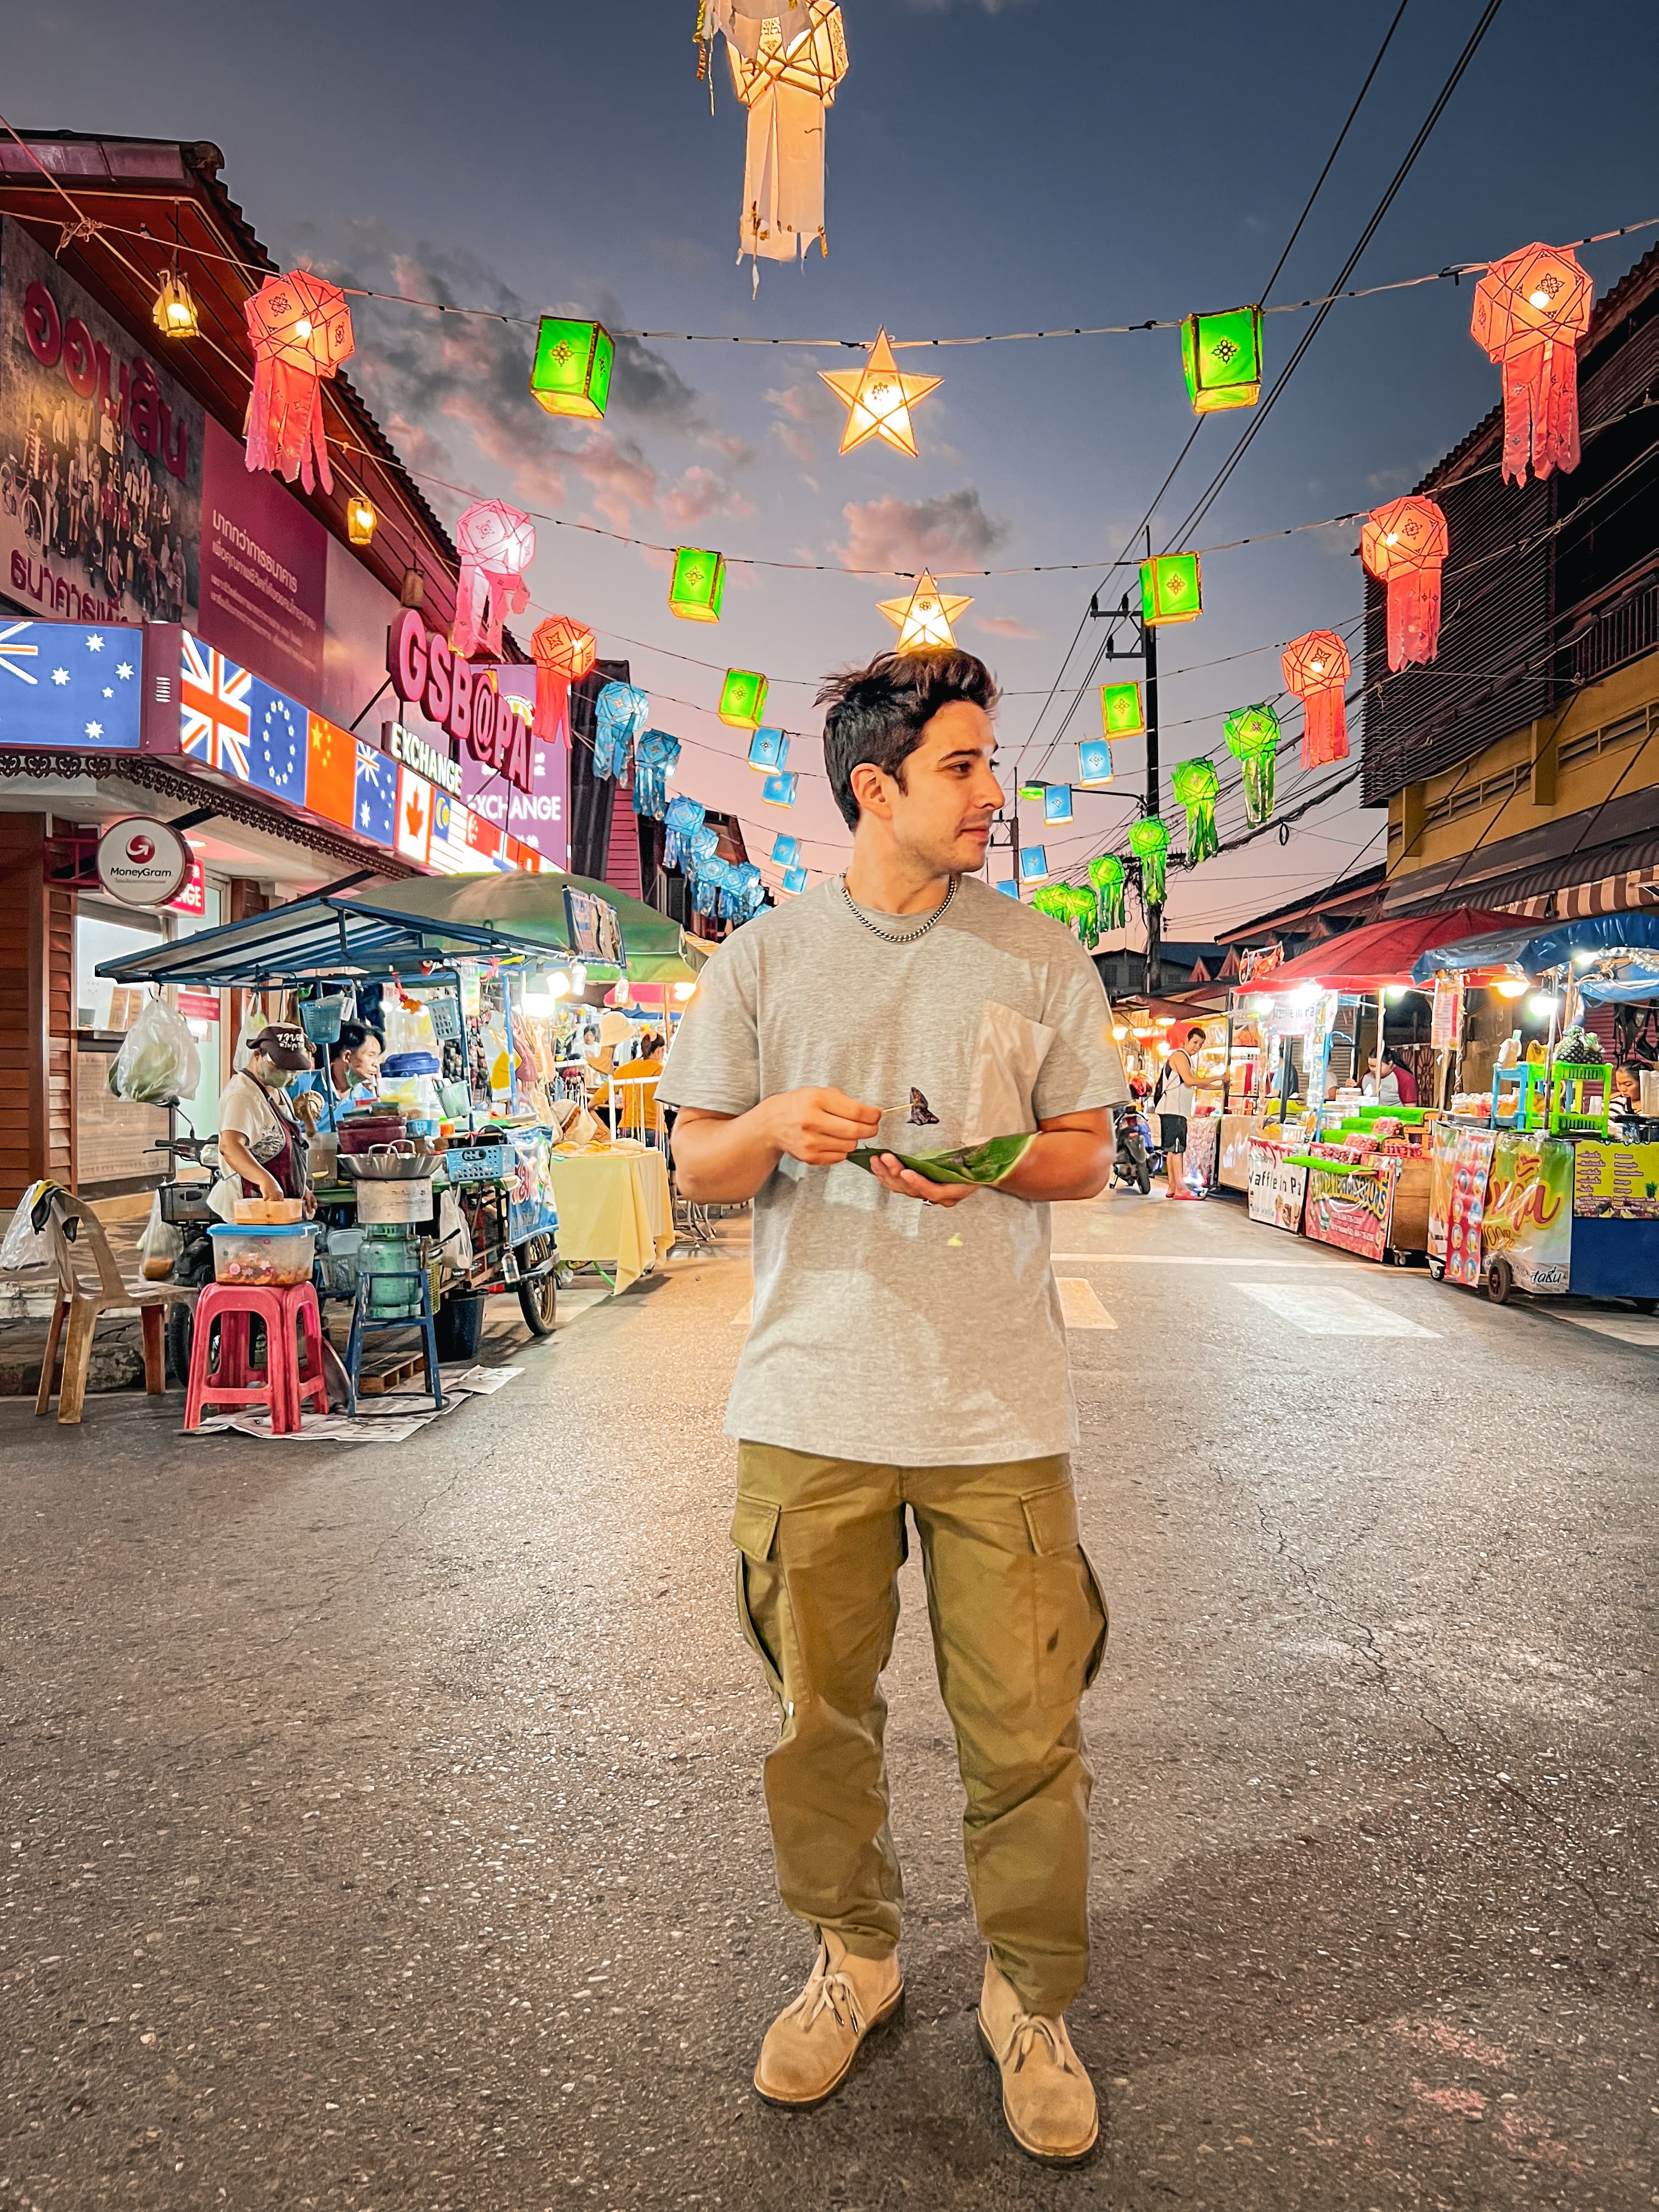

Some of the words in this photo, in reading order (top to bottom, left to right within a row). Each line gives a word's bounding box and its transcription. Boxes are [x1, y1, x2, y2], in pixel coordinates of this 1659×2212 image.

[24, 281, 187, 484] ออมสิน
[399, 609, 535, 794] GSB@PAI
[391, 721, 462, 795] EXCHANGE
[467, 795, 561, 820] EXCHANGE
[110, 867, 172, 878] MoneyGram
